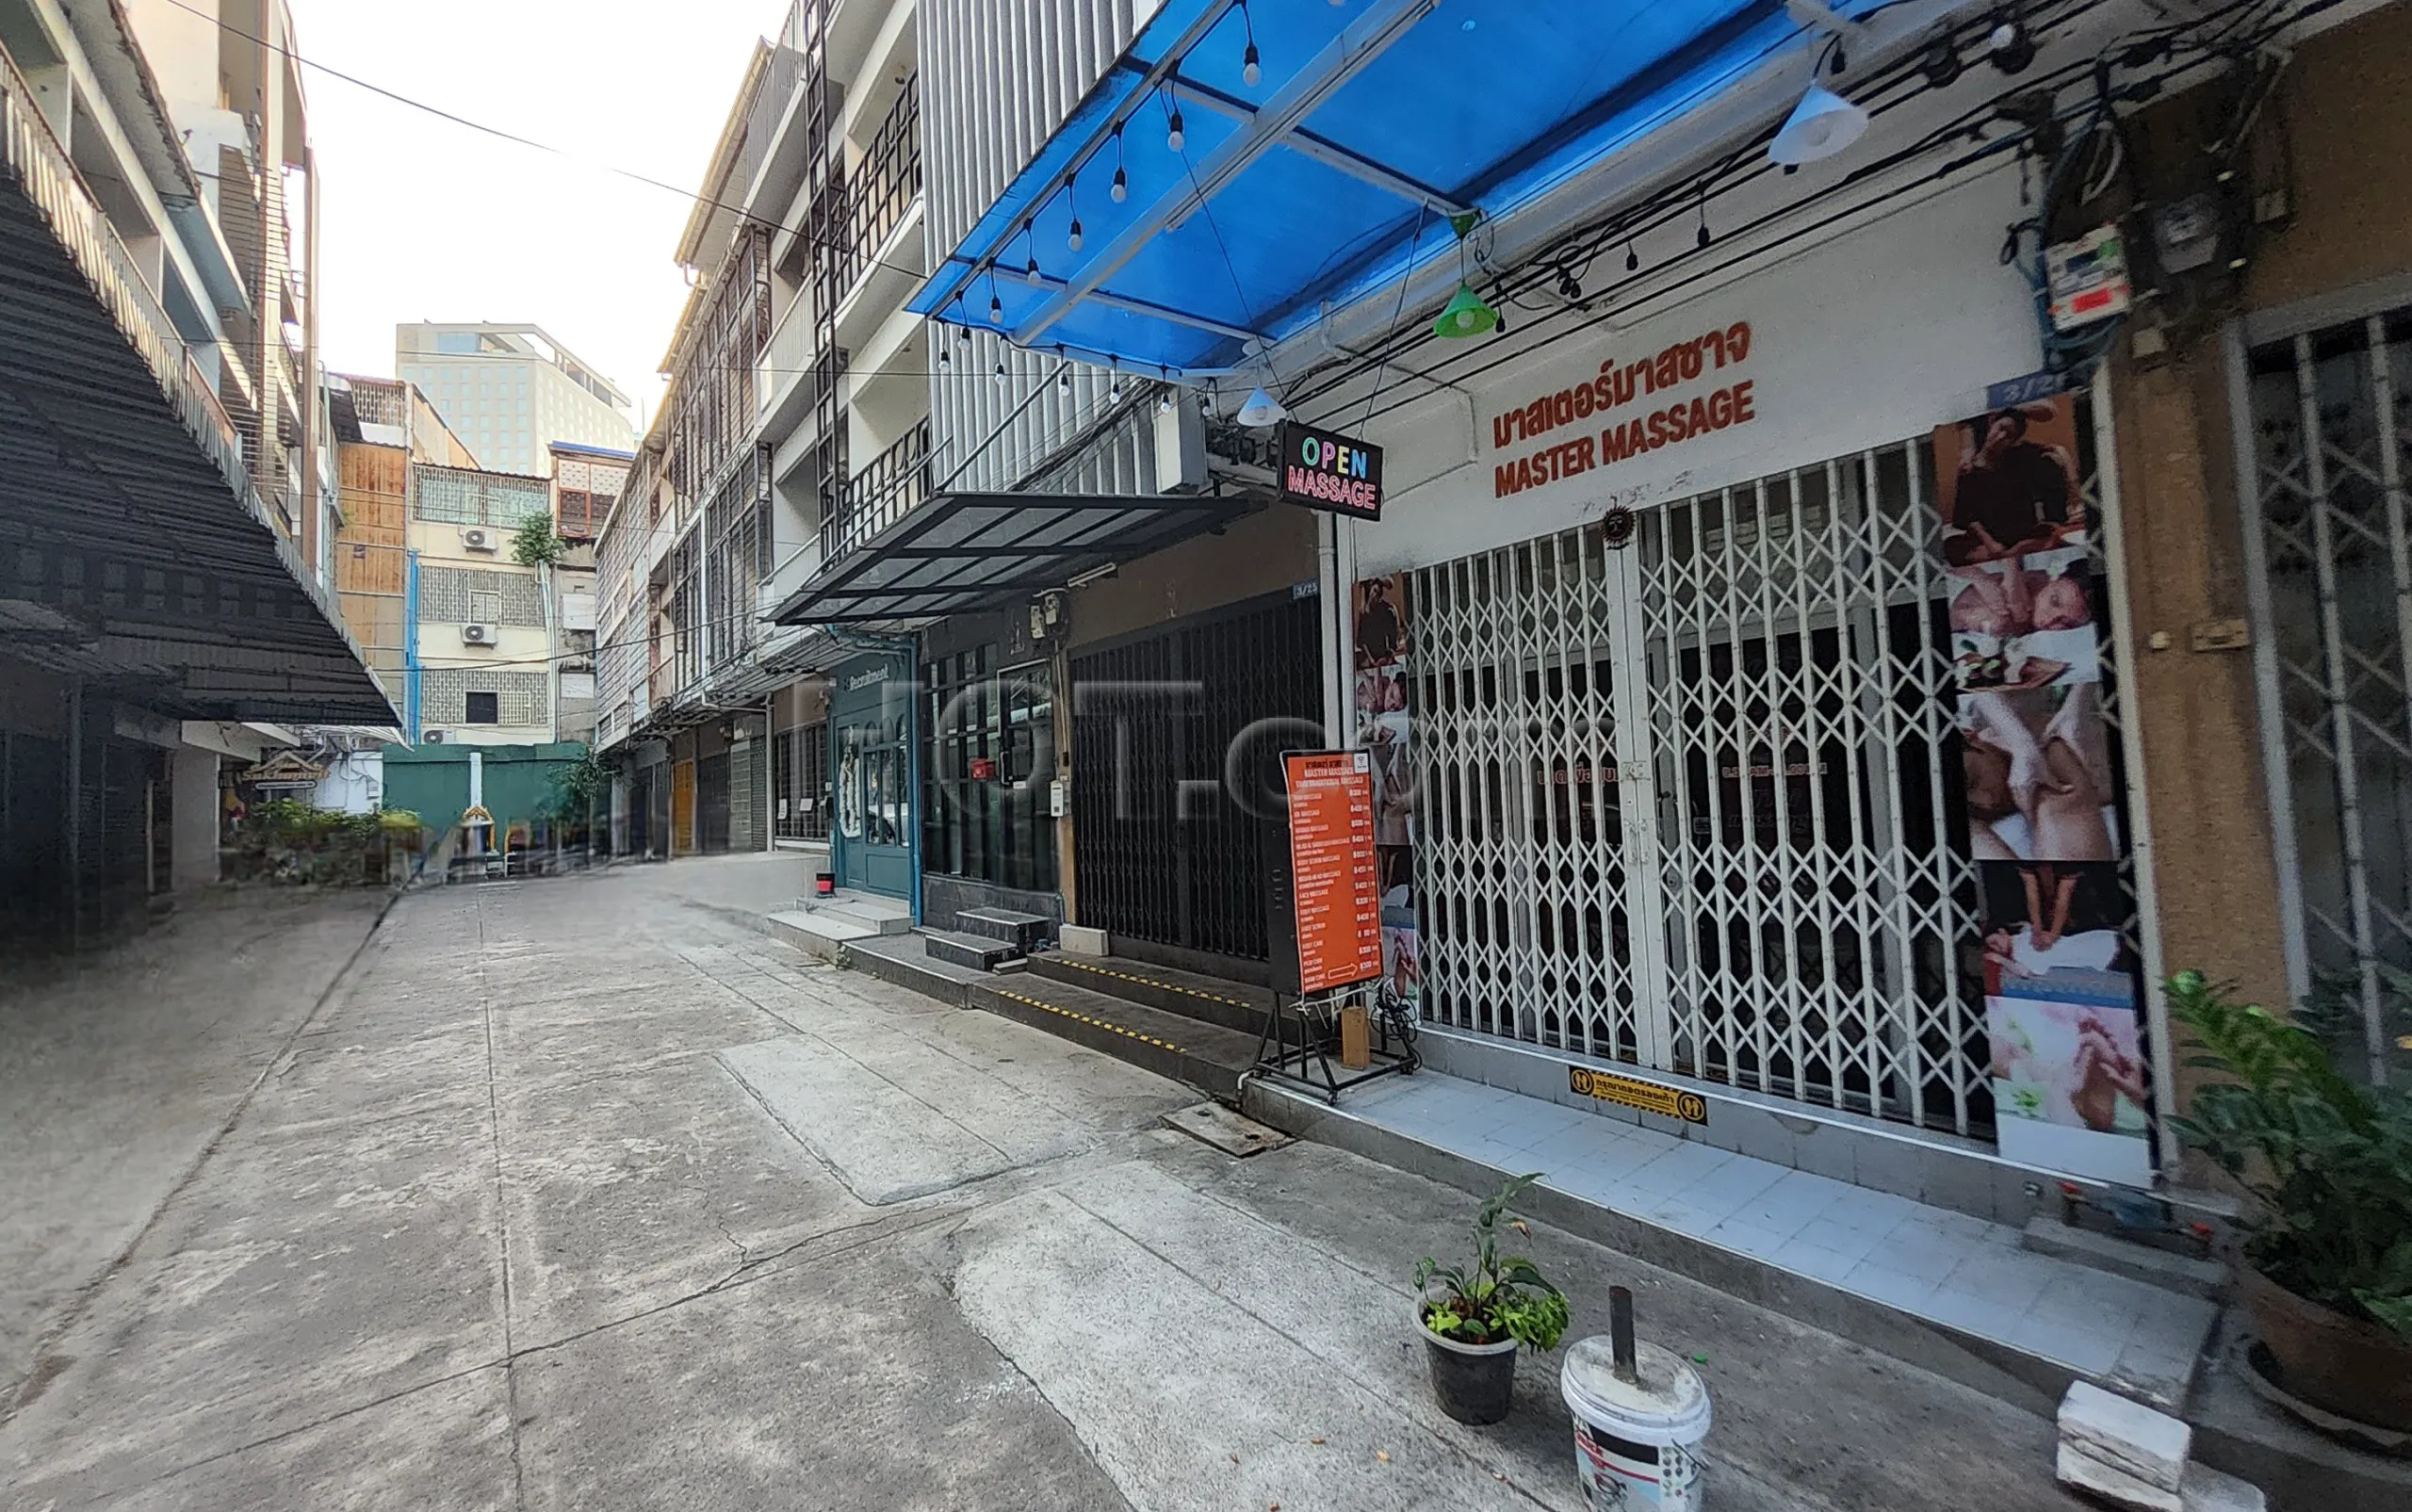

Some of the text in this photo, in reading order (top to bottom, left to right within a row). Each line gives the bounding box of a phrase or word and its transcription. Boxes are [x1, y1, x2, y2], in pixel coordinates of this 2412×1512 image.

[1302, 436, 1367, 479] OPEN
[1494, 380, 1755, 498] MASTER MASSAGE
[1288, 465, 1377, 511] MASSAGE
